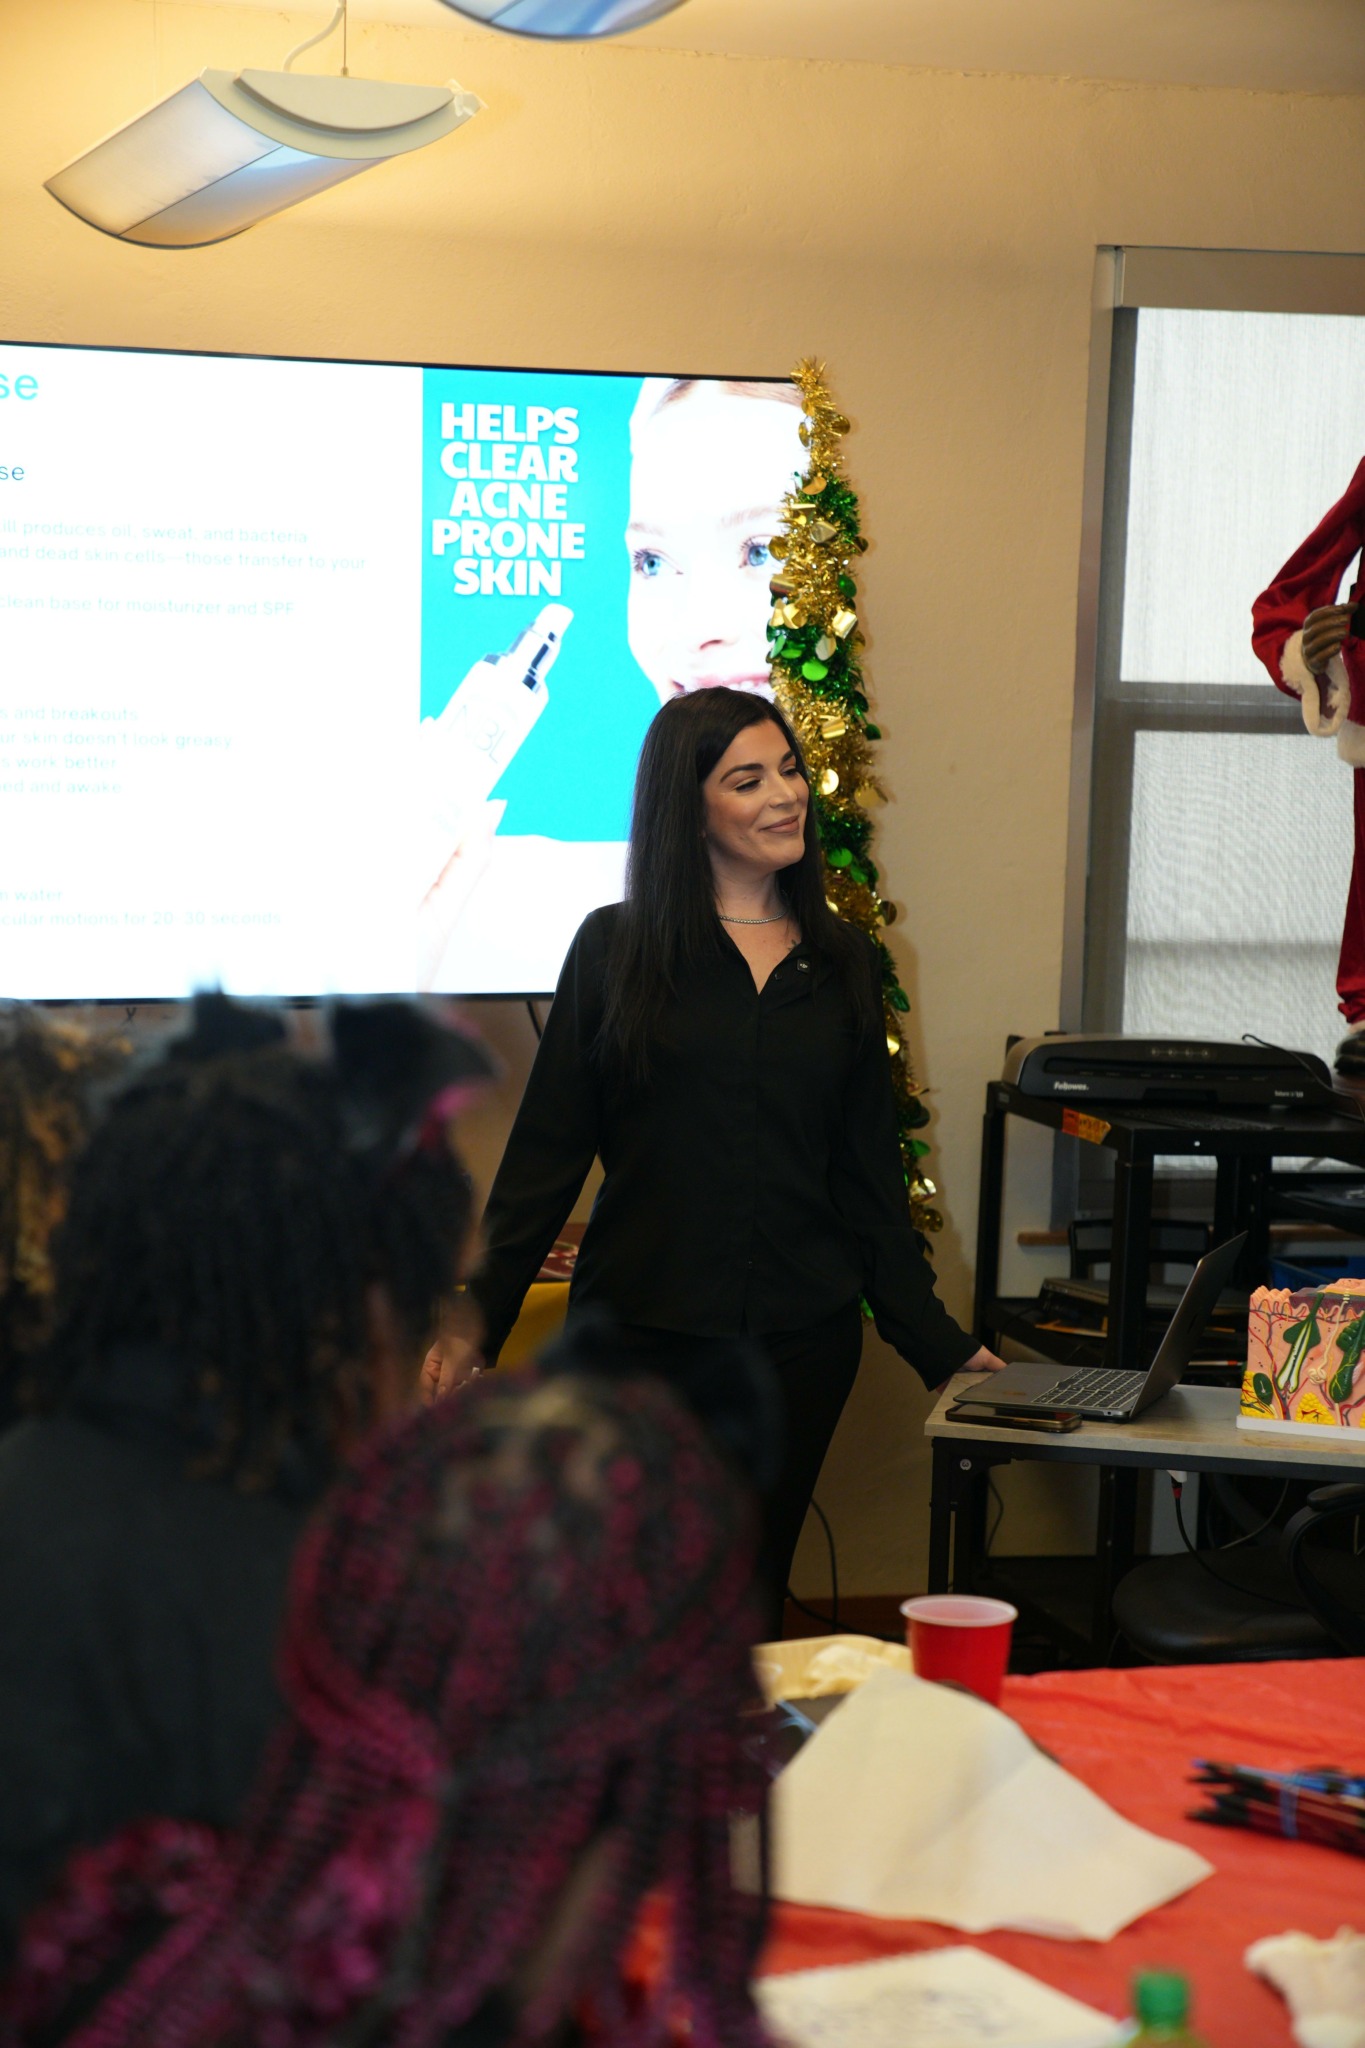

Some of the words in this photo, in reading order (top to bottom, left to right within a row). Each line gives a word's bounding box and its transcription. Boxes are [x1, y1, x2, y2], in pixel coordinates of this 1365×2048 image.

[441, 402, 580, 444] HELPS
[440, 441, 579, 483] CLEAR
[449, 481, 568, 520] ACNE
[23, 521, 107, 539] produces
[203, 526, 234, 542] and
[239, 527, 309, 545] bacteria
[432, 519, 585, 559] PRONE
[35, 545, 79, 561] dead
[85, 547, 119, 562] skin
[239, 552, 304, 568] transfer
[308, 554, 326, 569] to
[331, 557, 366, 573] your
[453, 558, 561, 596] SKIN
[49, 593, 92, 612] base
[97, 595, 121, 612] for
[126, 597, 222, 615] moisturizer
[227, 599, 258, 616] and
[263, 600, 297, 617] SPF
[14, 705, 45, 721] and
[51, 705, 139, 722] breakouts
[23, 730, 58, 745] skin
[133, 732, 169, 747] look
[175, 734, 233, 751] greasy
[16, 755, 57, 769] work
[64, 755, 118, 770] better
[30, 779, 61, 794] and
[66, 779, 123, 794] awake
[15, 887, 64, 902] water
[50, 911, 118, 926] motions
[124, 910, 148, 926] for
[211, 911, 282, 926] seconds
